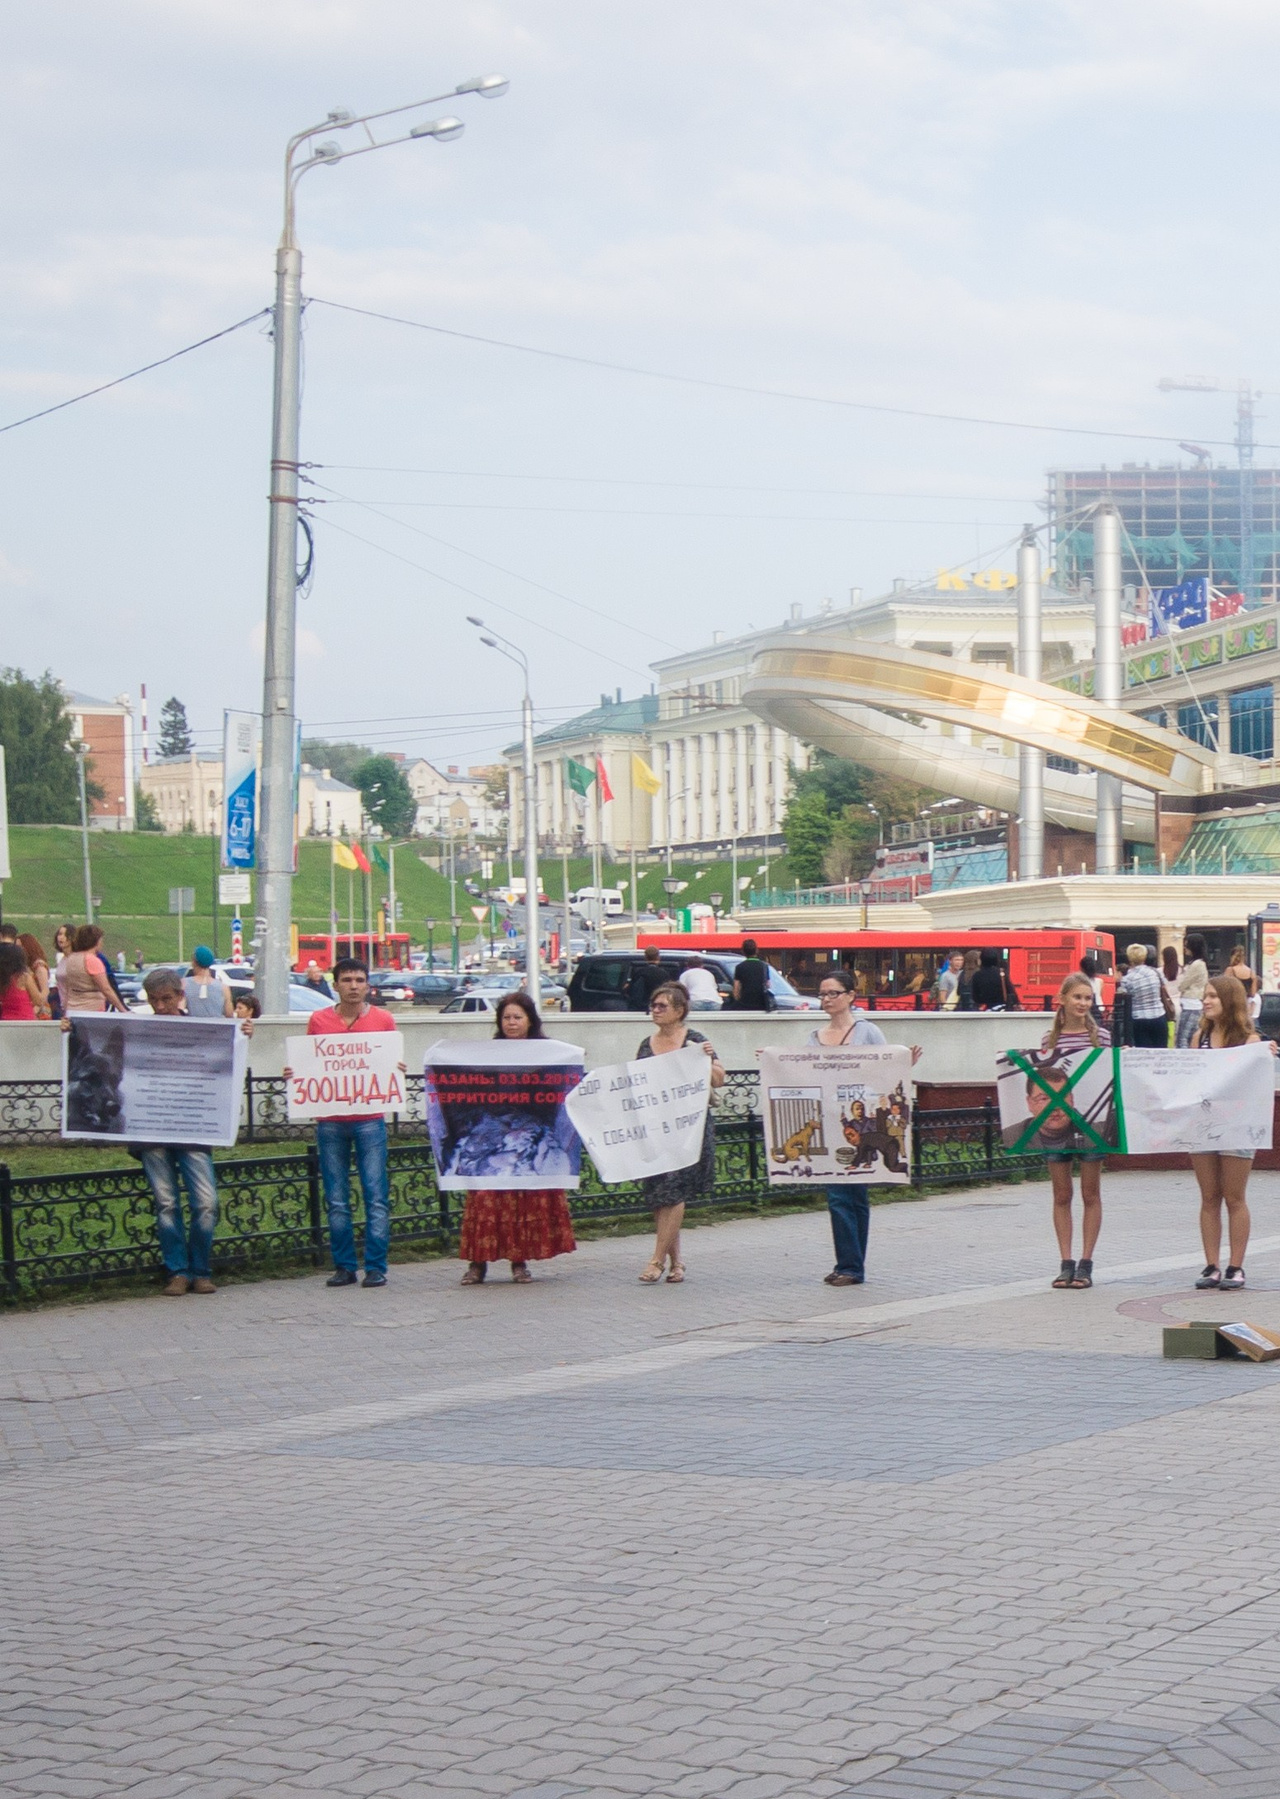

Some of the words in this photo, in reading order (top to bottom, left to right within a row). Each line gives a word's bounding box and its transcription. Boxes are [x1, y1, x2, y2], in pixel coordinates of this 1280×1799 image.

[881, 1053, 893, 1061] от
[428, 1073, 495, 1085] КАЗАНЬ:
[498, 1072, 580, 1085] 03.03.2013
[610, 1072, 648, 1092] ДОЛЖЕН
[293, 1073, 403, 1106] ЗООЦИДА
[428, 1092, 531, 1104] ТЕРРИТОРИЯ
[661, 1090, 669, 1103] В
[603, 1125, 648, 1146] СОБАКИ
[662, 1121, 670, 1134] В
